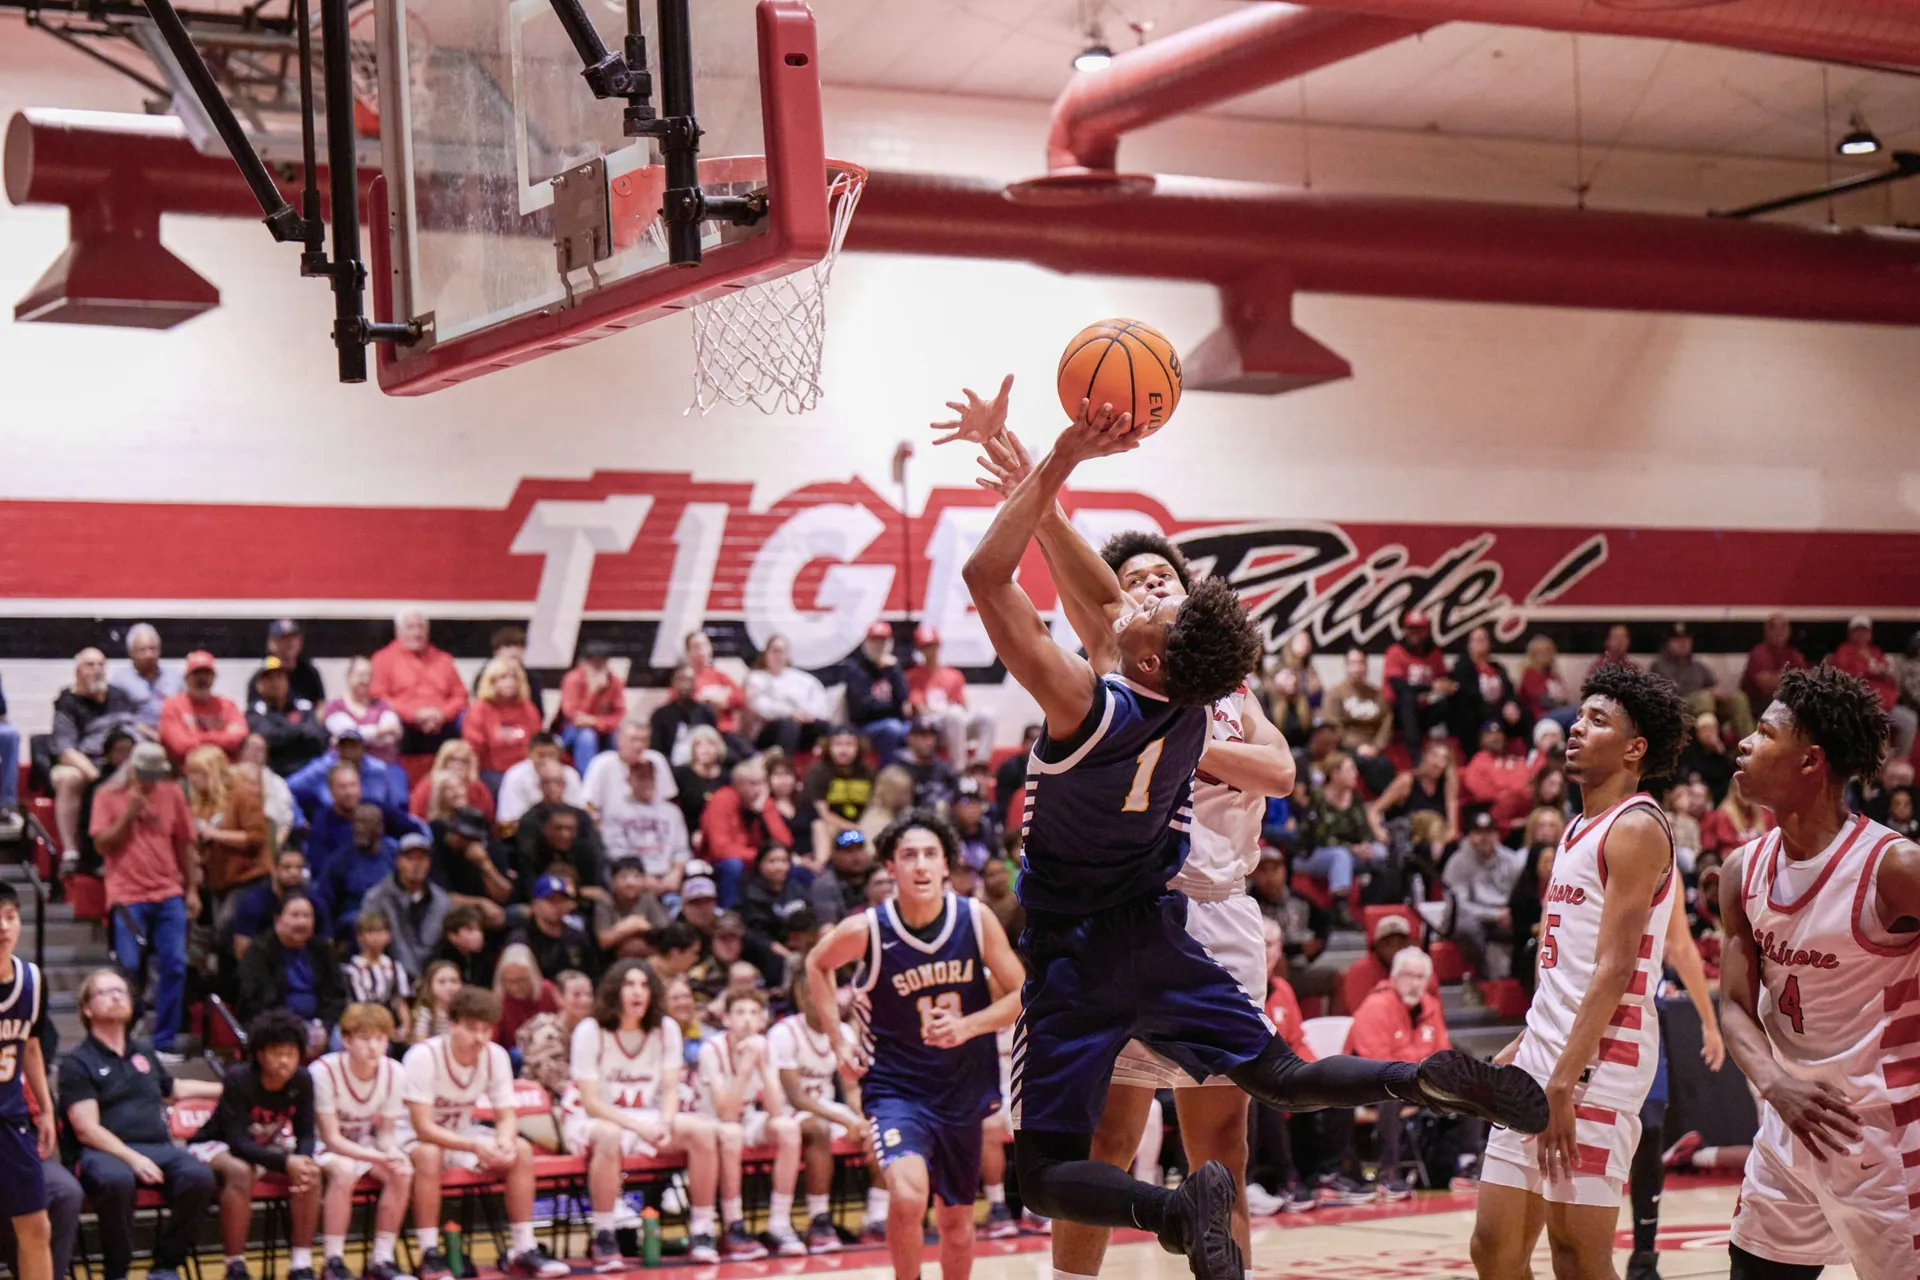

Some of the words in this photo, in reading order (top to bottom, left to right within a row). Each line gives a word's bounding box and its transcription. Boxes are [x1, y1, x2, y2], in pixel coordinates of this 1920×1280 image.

[1121, 736, 1165, 812] 1
[892, 958, 974, 997] SONORA
[1778, 973, 1804, 1035] 4
